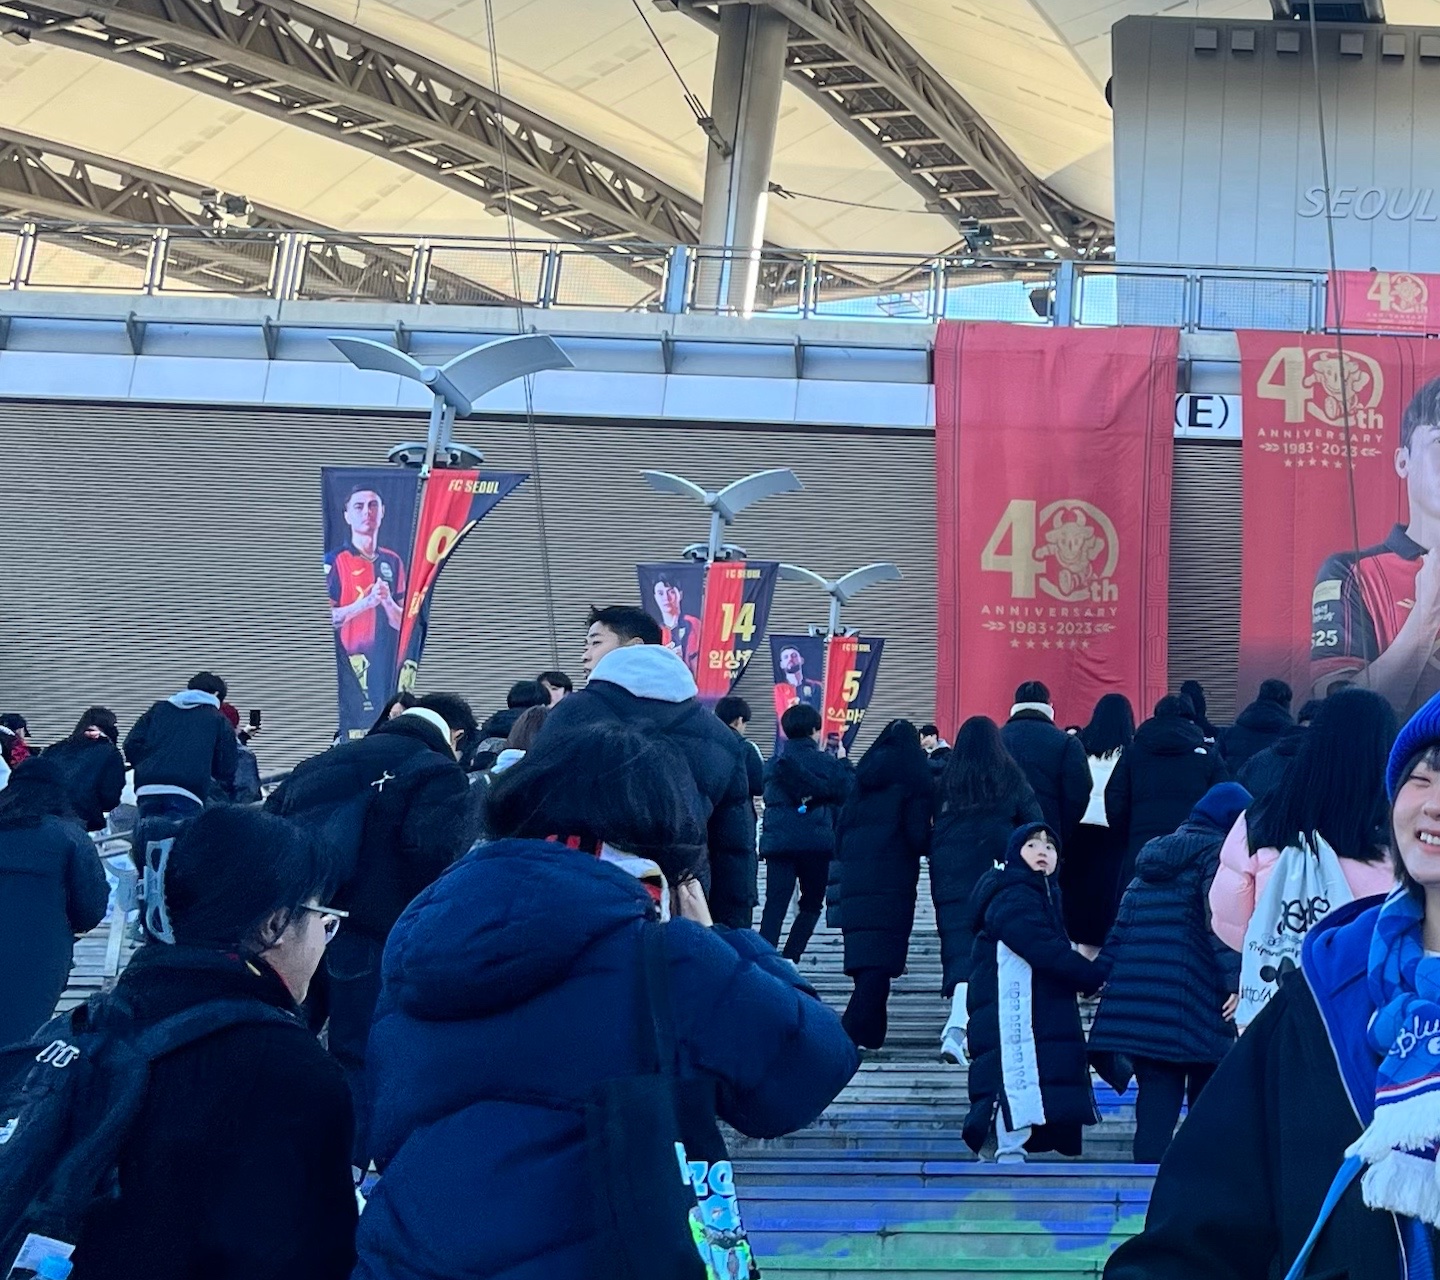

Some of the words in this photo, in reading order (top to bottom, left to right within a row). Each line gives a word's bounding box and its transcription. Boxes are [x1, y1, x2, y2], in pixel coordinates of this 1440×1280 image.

[1297, 185, 1438, 222] SEOUL
[1175, 393, 1229, 429] (E)
[1257, 427, 1383, 443] ANNIVERSARY
[448, 478, 463, 492] FC
[465, 480, 500, 494] SEOUL
[721, 603, 756, 642] 14
[981, 604, 1118, 618] ANNIVERSARY
[842, 670, 862, 703] 5
